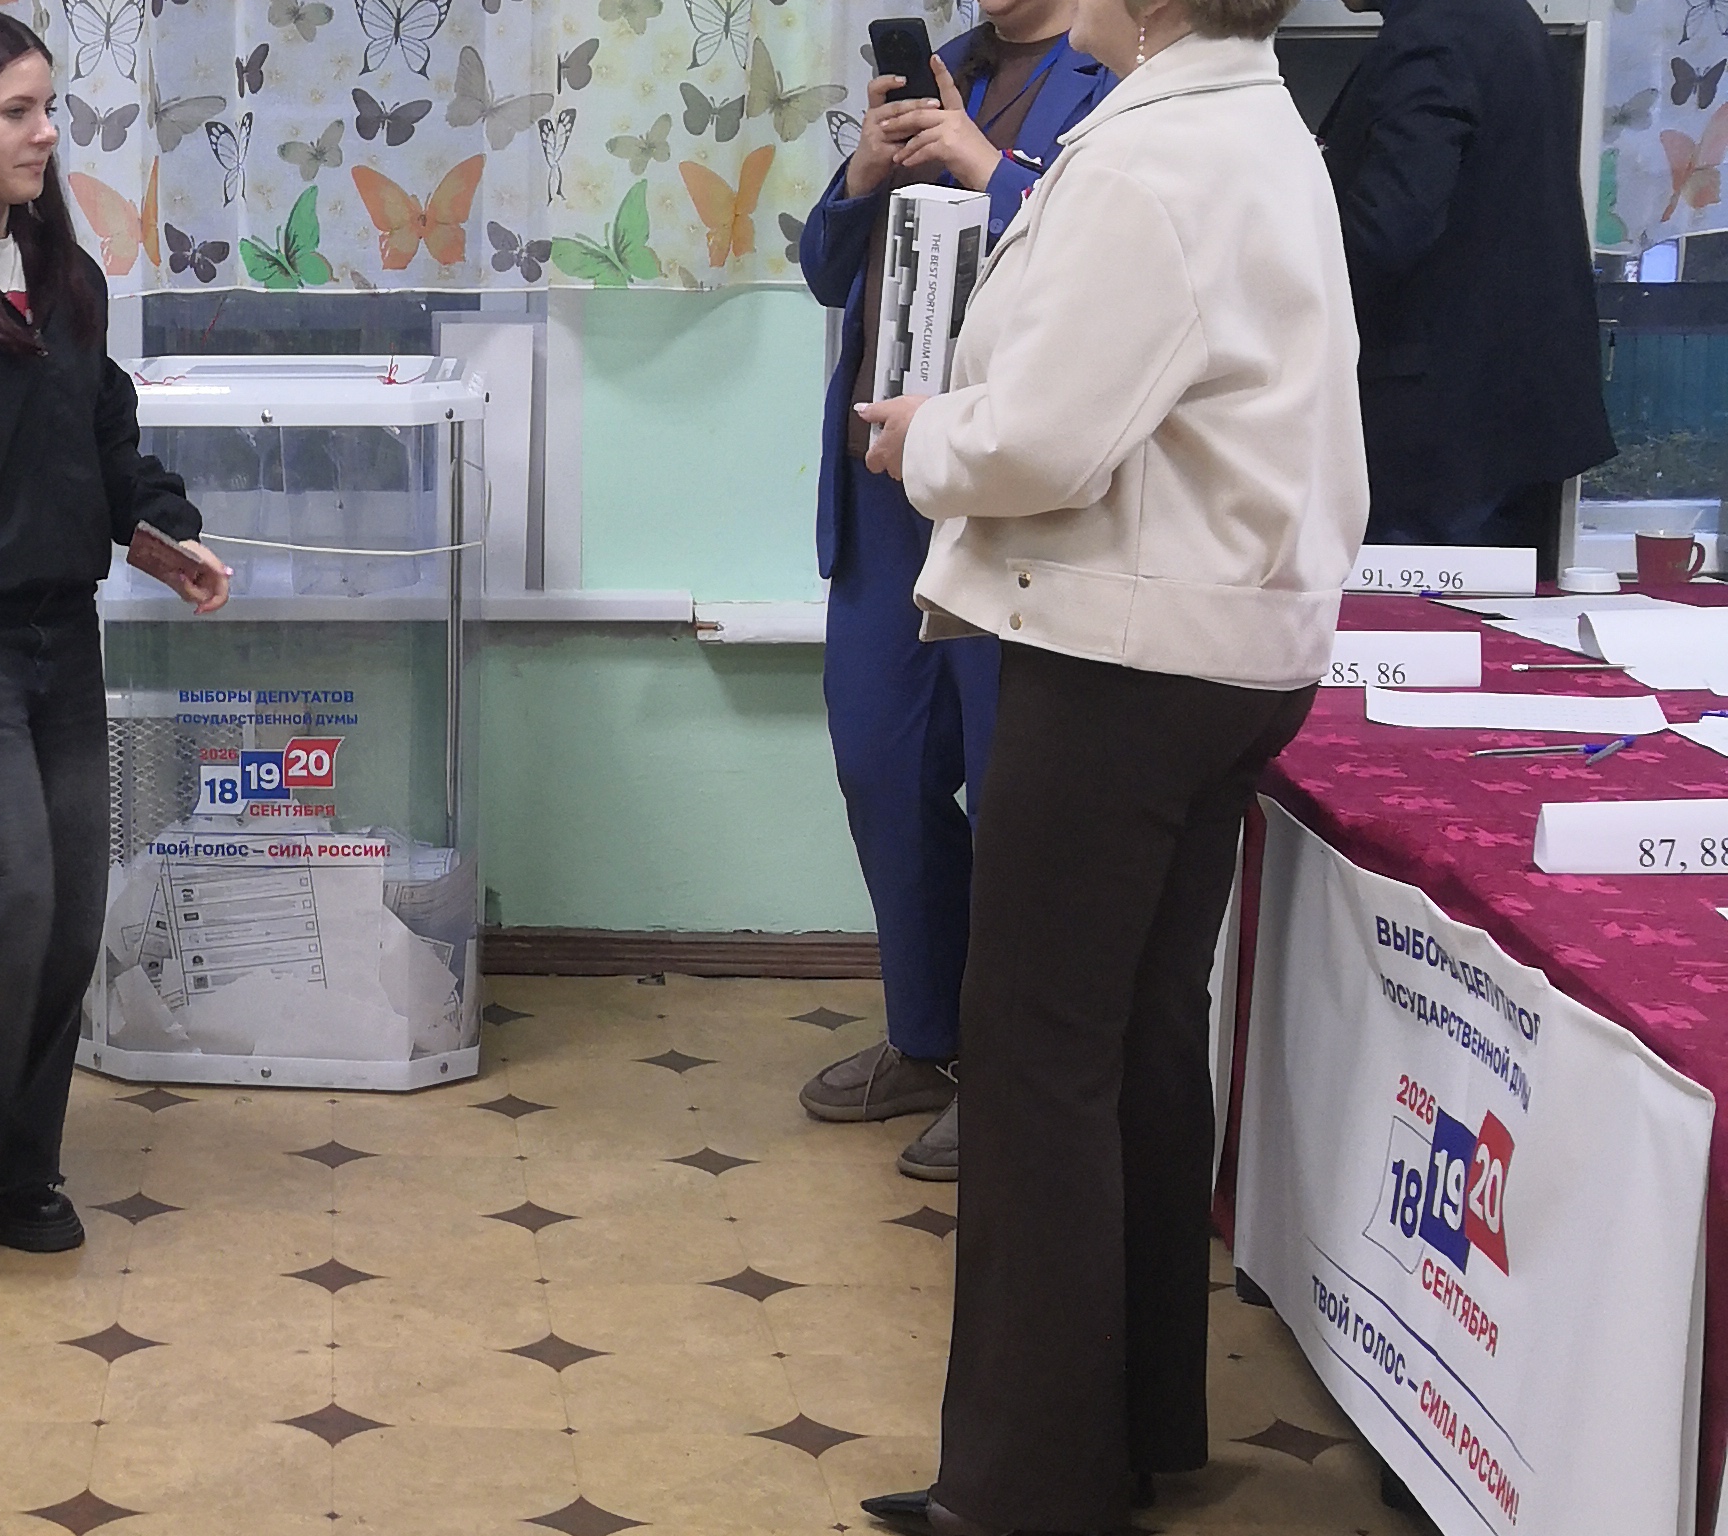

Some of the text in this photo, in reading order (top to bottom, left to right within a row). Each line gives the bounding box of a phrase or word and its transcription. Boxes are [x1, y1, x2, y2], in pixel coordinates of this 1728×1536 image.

[921, 233, 941, 382] THE BEST SPORT VACUUM CUP
[1362, 568, 1464, 590] 91, 92, 96
[1332, 662, 1406, 684] 85, 86
[179, 690, 354, 705] ВЫБОРЫ ДЕПУТАТОВ
[176, 713, 358, 727] ГОСУДАРСТВЕННОЙ ДУМЫ
[199, 748, 239, 760] 2026
[287, 749, 331, 777] 20
[245, 762, 281, 790] 19
[204, 778, 239, 804] 18
[249, 804, 336, 817] СЕНТЯБРЯ
[146, 841, 189, 857] ТВОЙ
[194, 844, 249, 857] ГОЛОС
[268, 845, 313, 858] СИЛА
[318, 844, 391, 858] РОССИИ!
[1639, 838, 1687, 873] 87,
[1396, 1074, 1436, 1125] 2026
[1390, 1159, 1422, 1238] 18
[1432, 1149, 1465, 1231] 19
[1468, 1144, 1502, 1234] 20
[1422, 1258, 1499, 1358] СЕНТЯБРЯ
[1312, 1275, 1350, 1335] ТВОЙ
[1353, 1313, 1405, 1385] ГОЛОС
[1420, 1380, 1458, 1448] СИЛА
[1458, 1424, 1519, 1526] РОССИИ!
